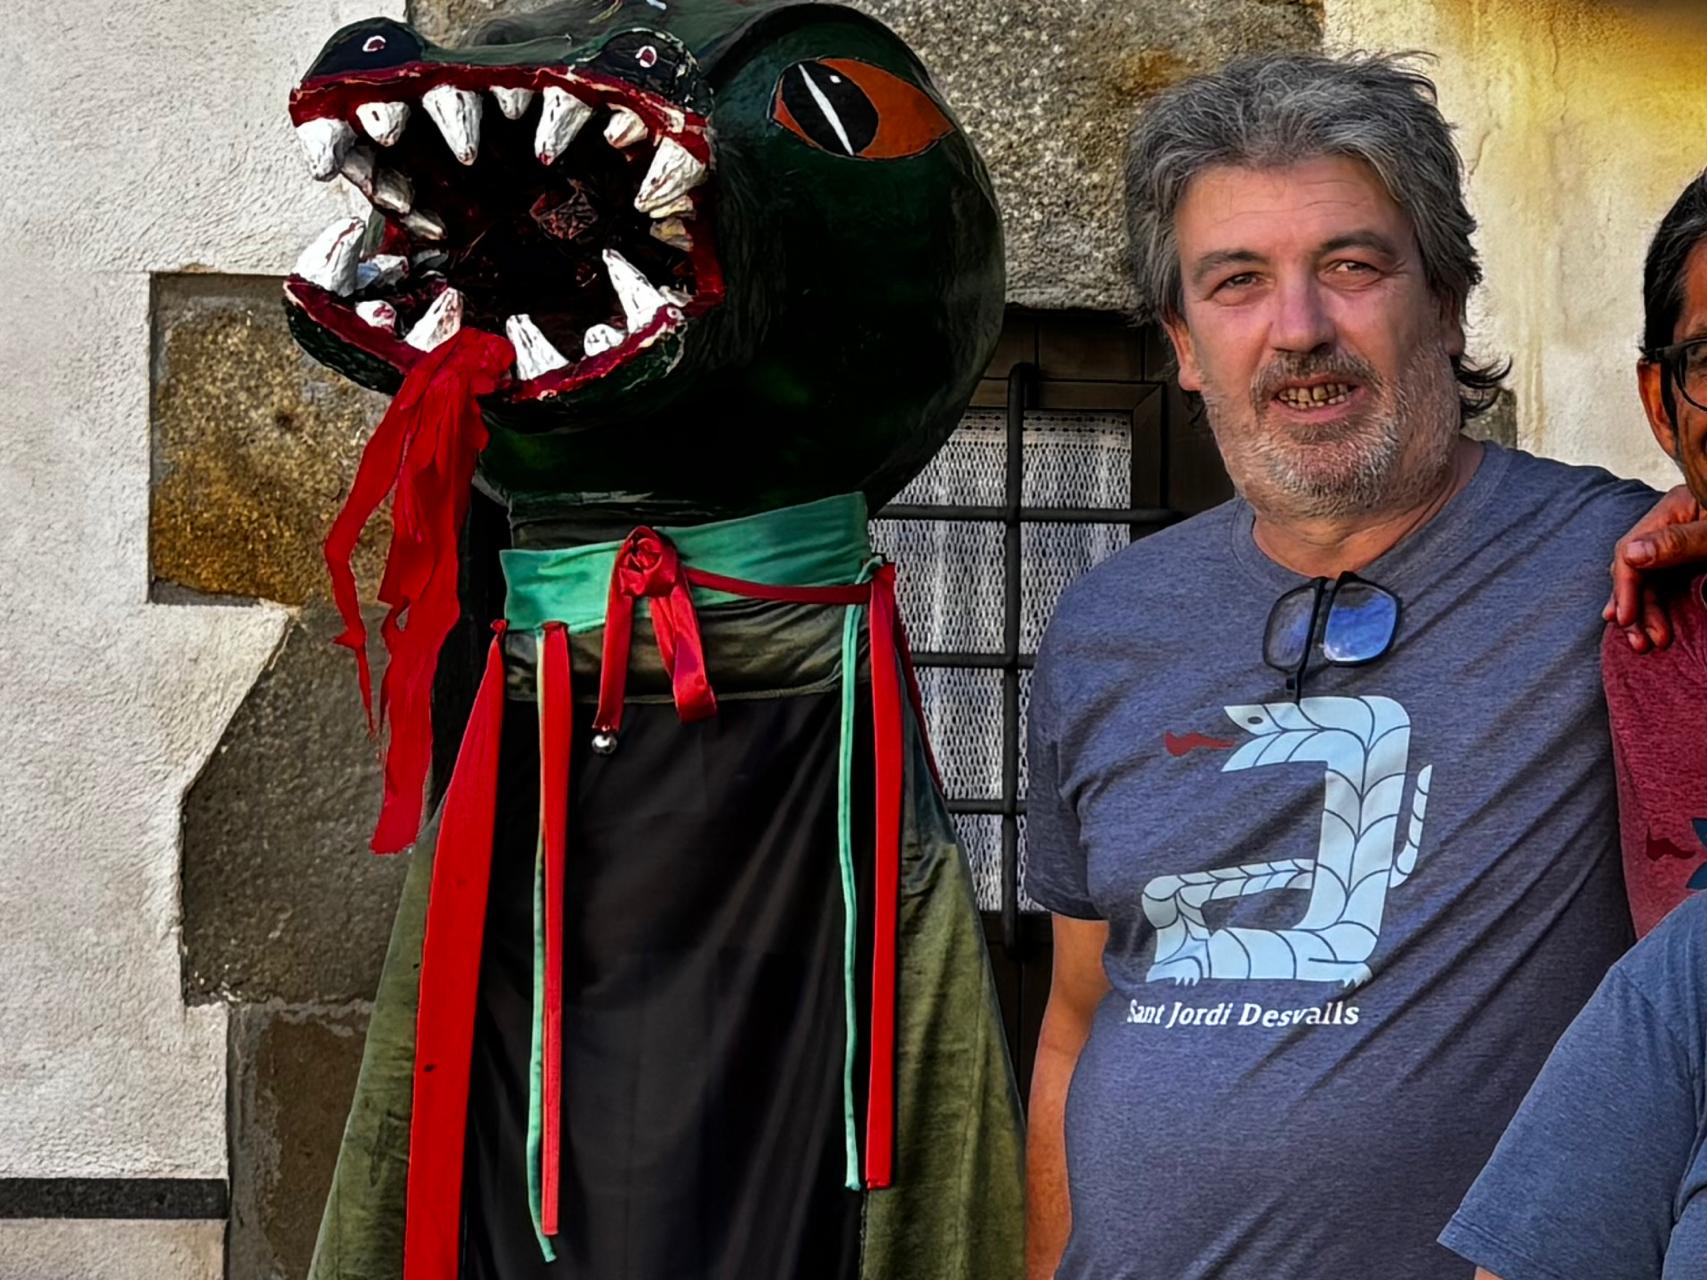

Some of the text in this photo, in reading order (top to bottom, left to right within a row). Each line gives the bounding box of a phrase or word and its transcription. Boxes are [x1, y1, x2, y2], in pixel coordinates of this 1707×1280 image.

[1127, 999, 1360, 1029] Sant Jordi Desvalls
